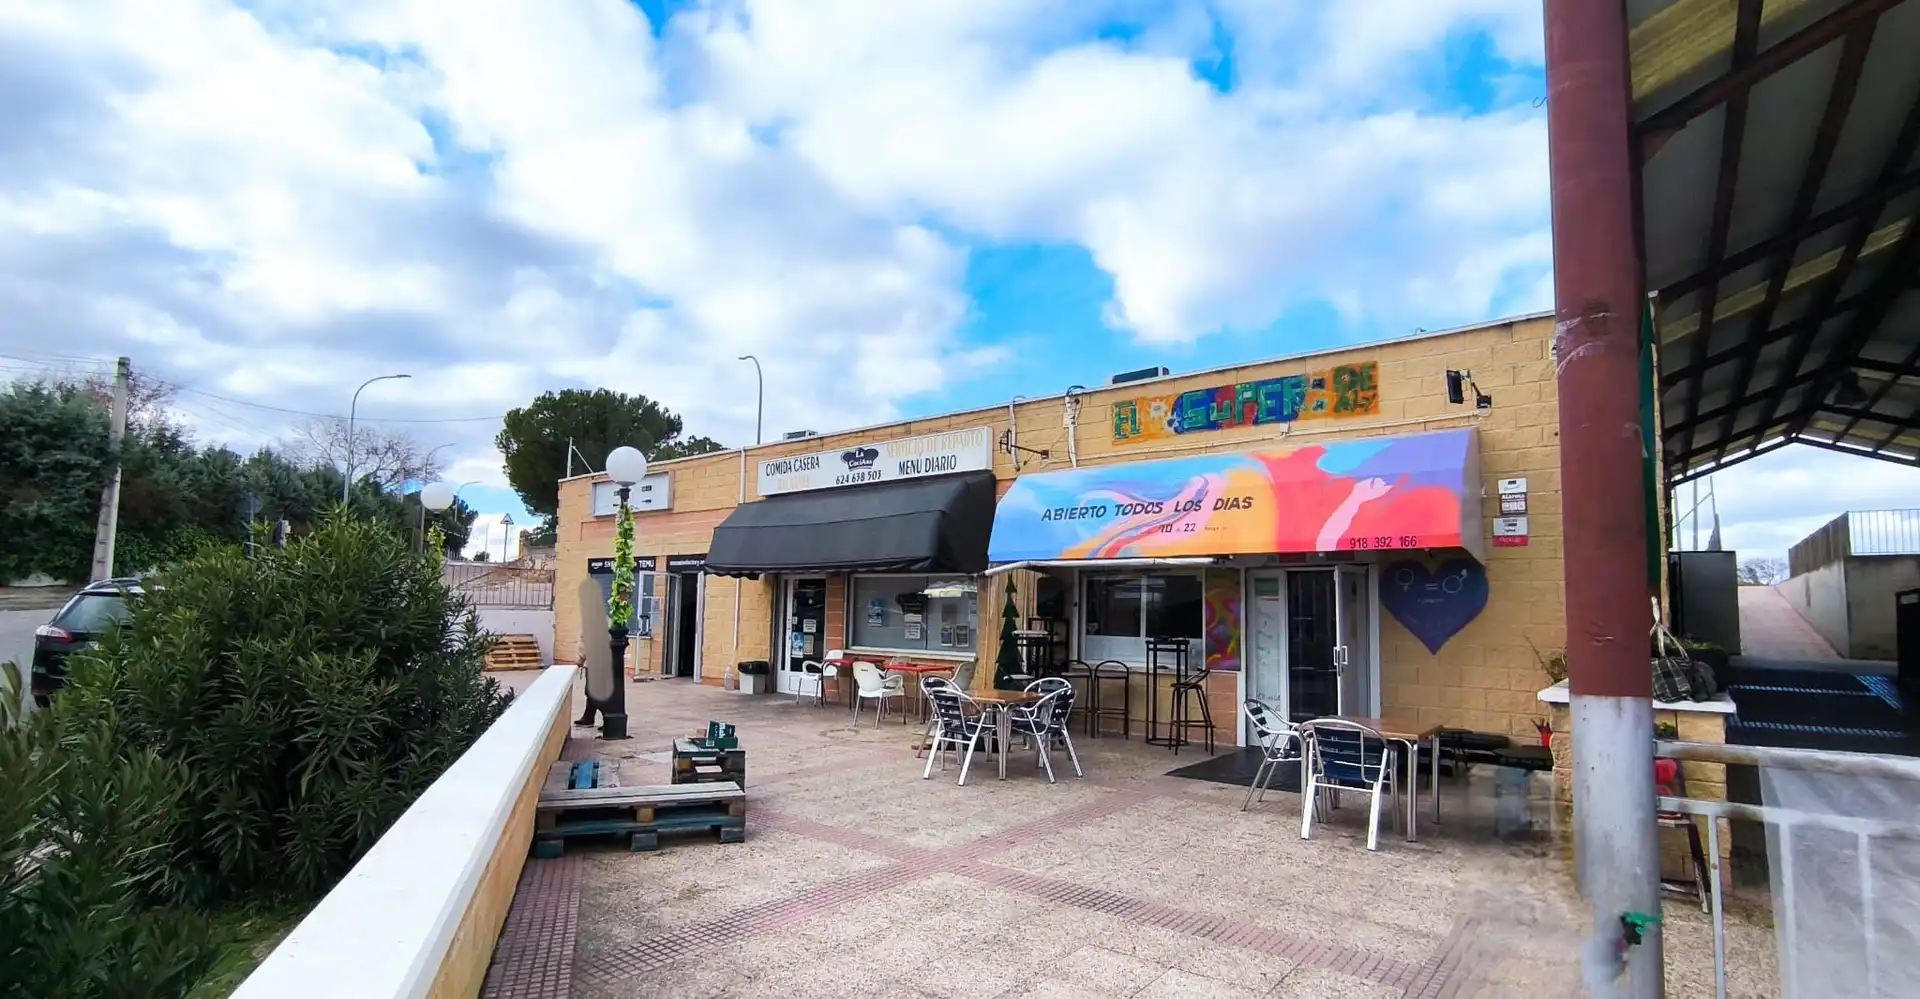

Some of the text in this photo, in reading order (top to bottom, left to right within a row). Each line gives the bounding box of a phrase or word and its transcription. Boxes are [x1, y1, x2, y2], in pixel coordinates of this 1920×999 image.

[1182, 374, 1307, 429] SUPER
[765, 456, 820, 476] COMIDA CASERA
[925, 454, 957, 473] DIARIO
[836, 469, 881, 485] 624 638 503
[1041, 495, 1254, 521] ABIERTO TODOS LOS DIAS
[1184, 523, 1196, 532] 22
[1350, 535, 1417, 549] 918 392 166
